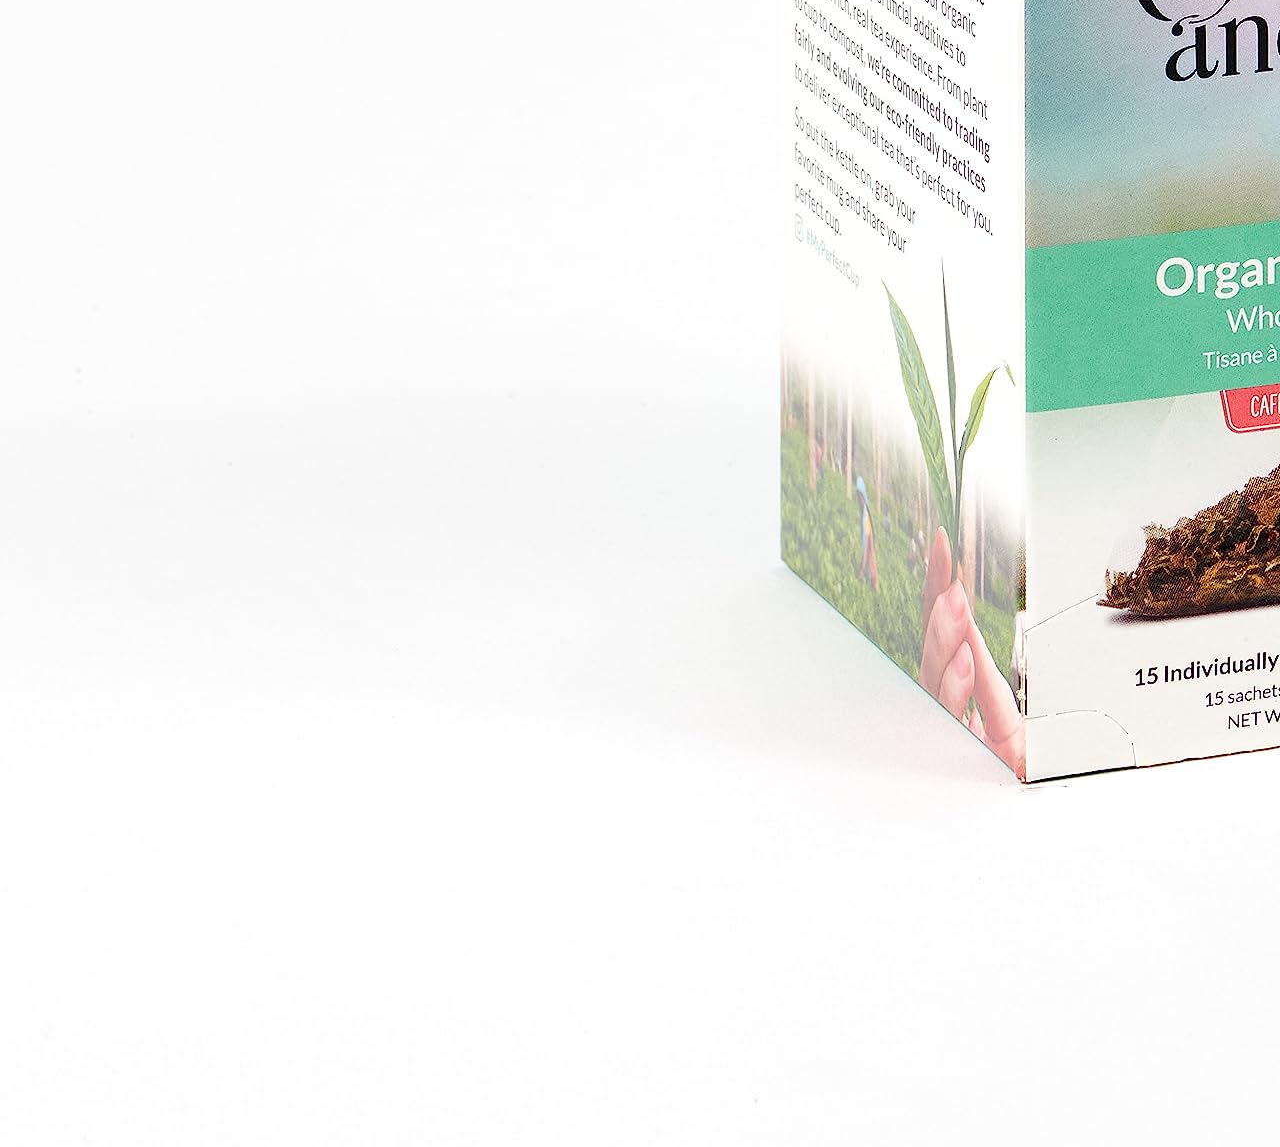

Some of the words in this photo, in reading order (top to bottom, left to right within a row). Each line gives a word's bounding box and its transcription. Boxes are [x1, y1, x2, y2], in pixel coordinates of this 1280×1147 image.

[914, 16, 954, 59] additives
[956, 44, 965, 67] to
[941, 1, 976, 37] organic
[829, 23, 866, 68] compost,
[868, 53, 891, 84] we're
[893, 74, 940, 123] committed
[943, 108, 953, 131] to
[955, 117, 990, 163] trading
[885, 32, 935, 82] experience.
[938, 64, 961, 102] From
[964, 88, 987, 120] plant
[833, 62, 868, 106] evolving
[869, 92, 884, 114] our
[886, 105, 940, 162] eco-friendly
[942, 148, 985, 193] practices
[832, 97, 878, 147] exceptional
[896, 145, 920, 180] that's
[922, 169, 955, 212] perfect
[957, 191, 970, 218] for
[973, 208, 993, 236] you.
[875, 180, 894, 207] grab
[896, 196, 915, 224] your
[862, 202, 885, 236] share
[887, 225, 906, 253] your
[1202, 348, 1263, 370] Tisane
[1266, 345, 1278, 363] à
[1135, 667, 1158, 687] 15
[1164, 652, 1279, 683] Individually
[1205, 691, 1224, 708] 15
[1227, 711, 1262, 730] NET
